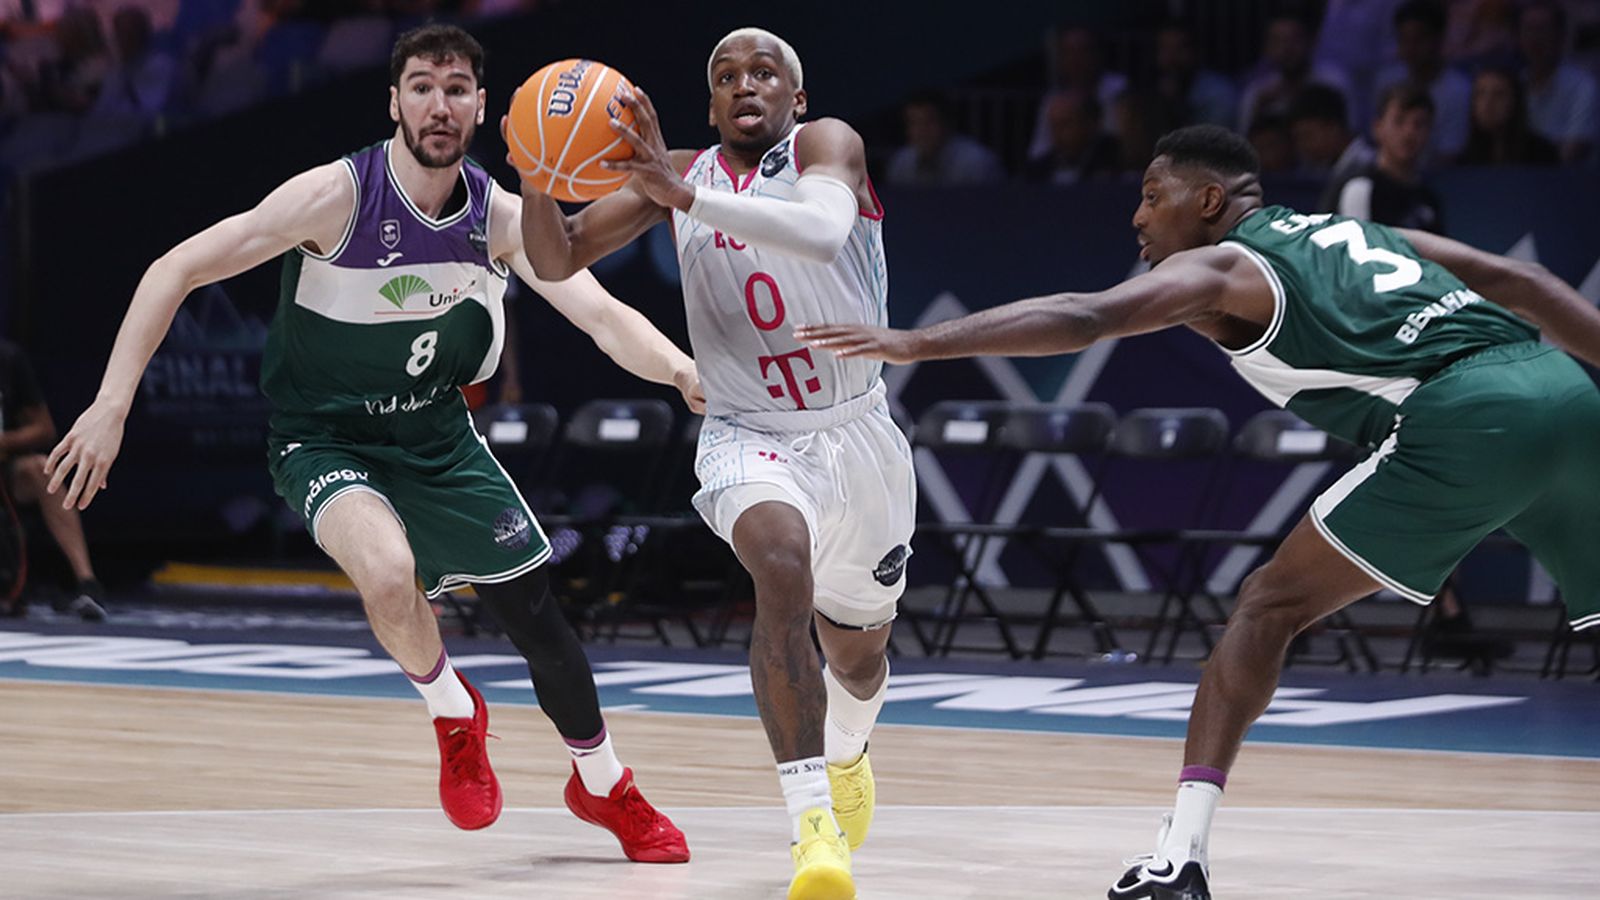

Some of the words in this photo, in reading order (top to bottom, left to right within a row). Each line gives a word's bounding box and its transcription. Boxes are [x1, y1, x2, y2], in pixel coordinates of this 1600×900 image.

[1309, 220, 1422, 293] 3
[744, 272, 785, 331] 0
[406, 330, 438, 377] 8
